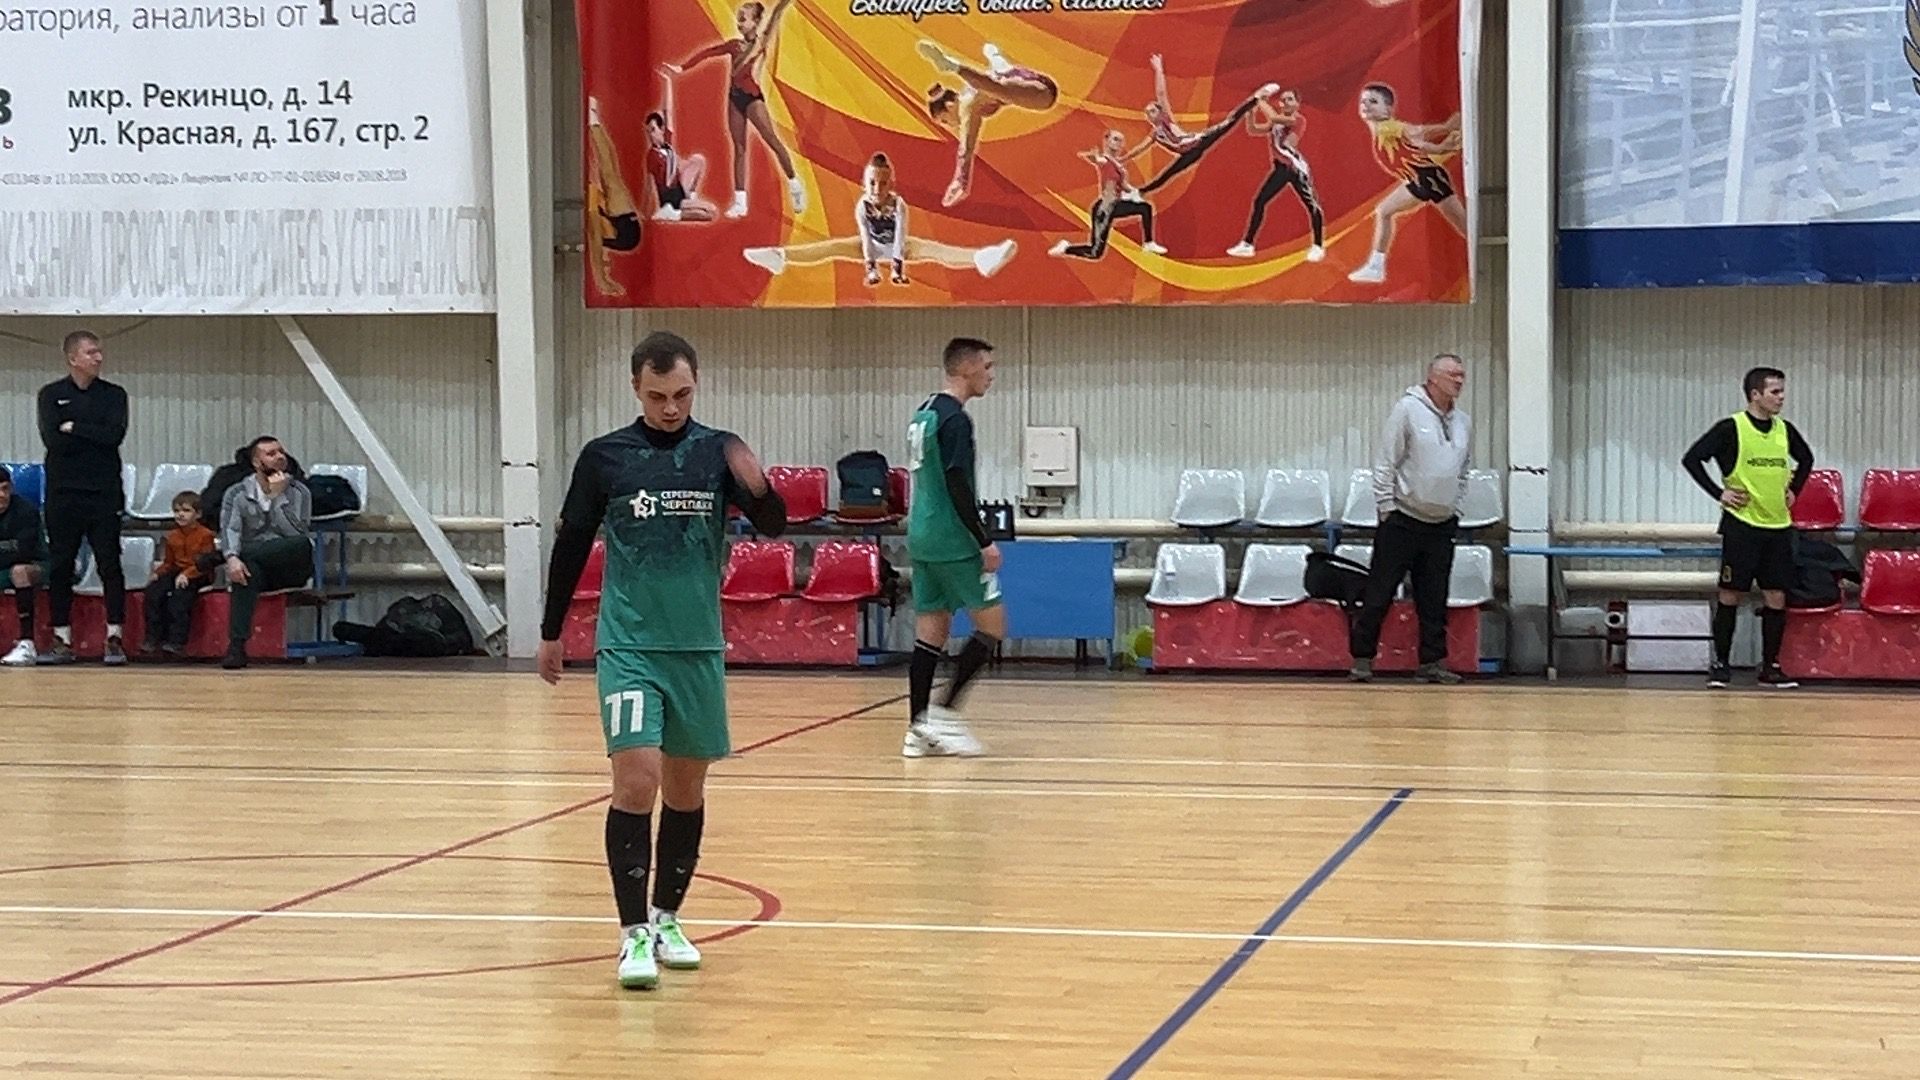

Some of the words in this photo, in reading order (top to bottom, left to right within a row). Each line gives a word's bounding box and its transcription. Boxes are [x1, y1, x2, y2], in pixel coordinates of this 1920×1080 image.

[132, 6, 265, 30] анализы
[276, 4, 309, 28] от
[319, 0, 340, 26] 1
[351, 1, 417, 26] часа
[68, 89, 132, 116] мкр.
[143, 82, 275, 112] Рекинцо,
[281, 86, 308, 113] д.
[318, 79, 353, 106] 14
[68, 125, 107, 153] ул.
[117, 119, 244, 153] Красная,
[252, 124, 278, 149] д.
[286, 117, 346, 147] 167,
[355, 121, 407, 150] стр.
[414, 115, 430, 141] 2
[995, 509, 1007, 530] 1
